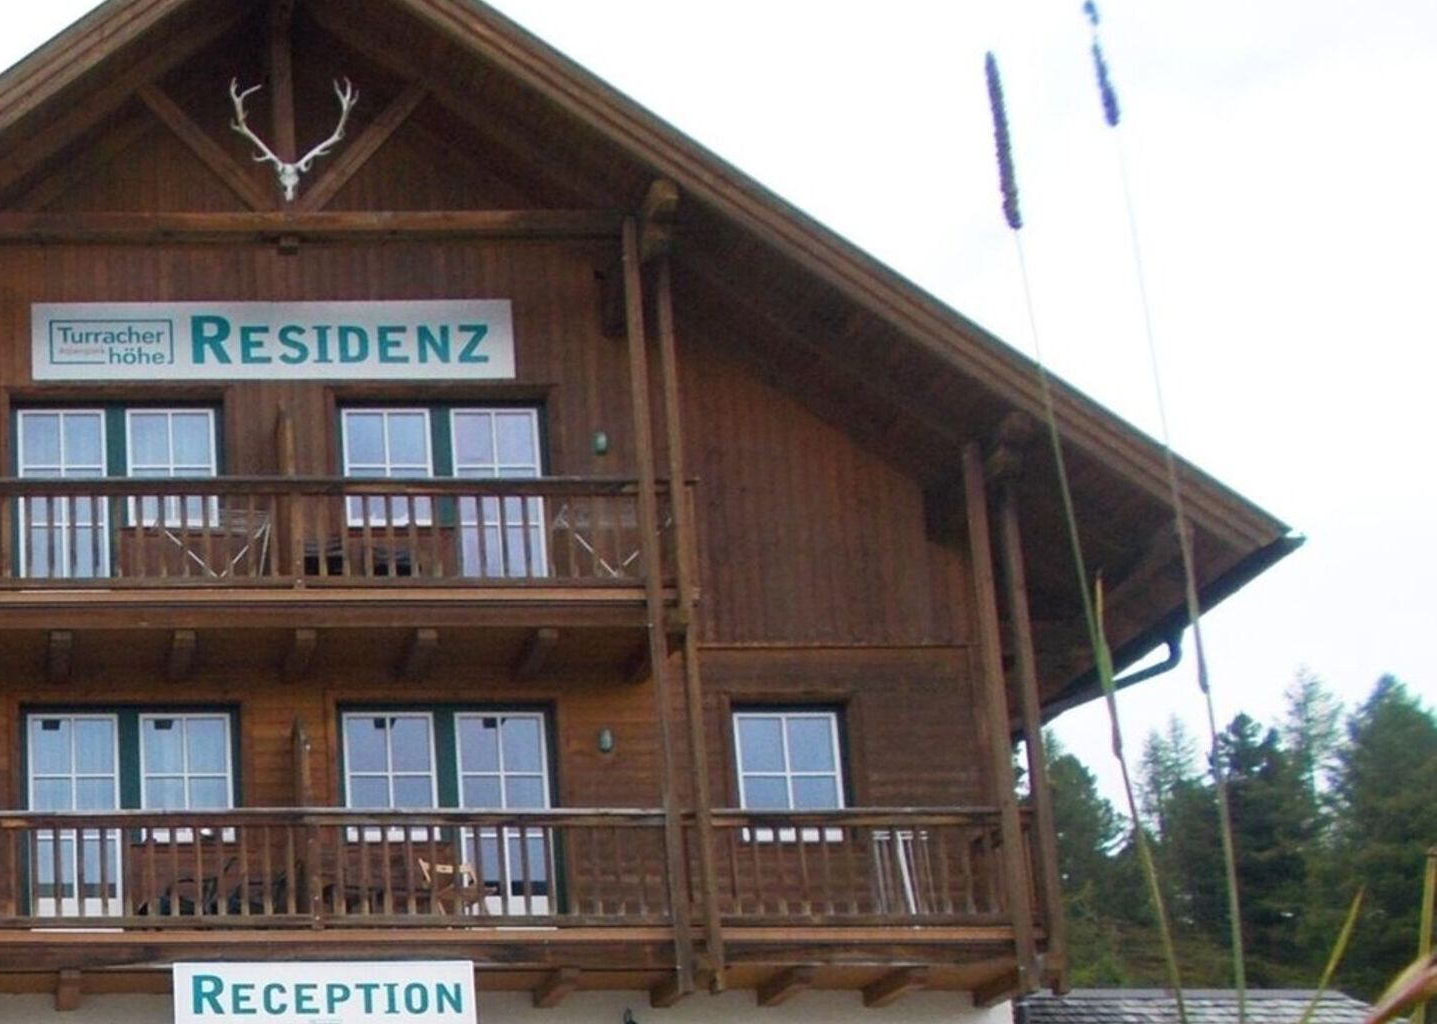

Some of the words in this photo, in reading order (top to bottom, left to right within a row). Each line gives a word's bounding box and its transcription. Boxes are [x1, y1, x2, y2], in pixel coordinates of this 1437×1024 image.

[57, 325, 165, 344] Turracher
[190, 315, 490, 365] RESIDENZ
[109, 346, 165, 365] höhe
[192, 974, 463, 1015] RECEPTION
